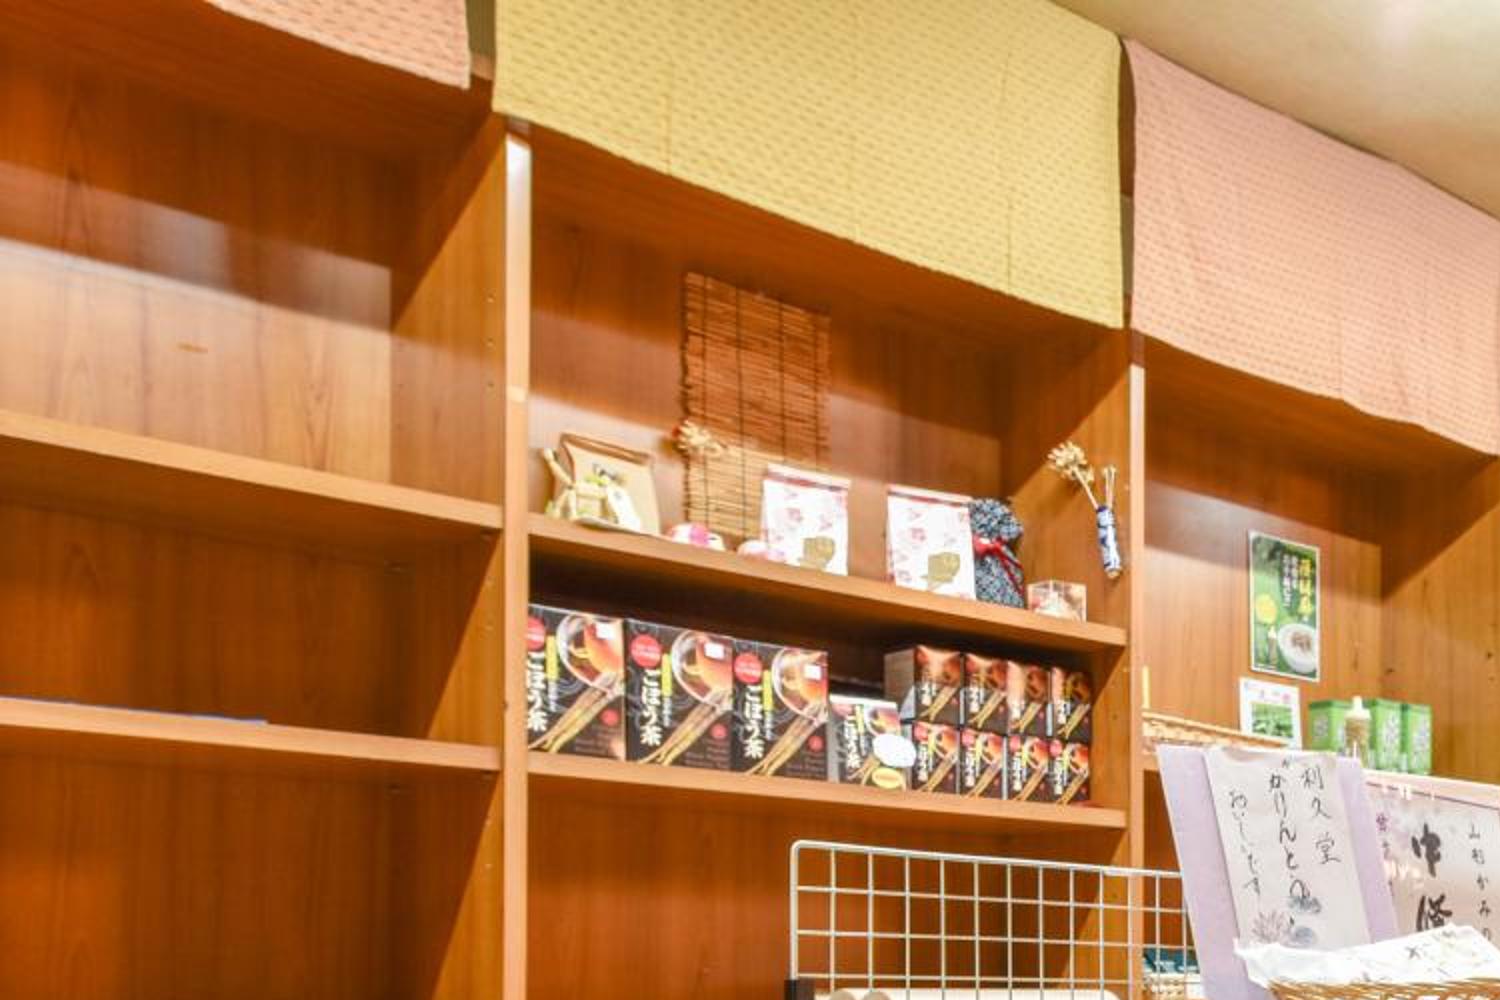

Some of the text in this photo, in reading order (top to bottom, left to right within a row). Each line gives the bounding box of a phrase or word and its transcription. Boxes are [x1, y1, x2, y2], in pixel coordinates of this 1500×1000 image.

[640, 669, 662, 747] ごぼう茶
[743, 685, 764, 760] ごぼう茶
[1301, 765, 1342, 865] 利久堂
